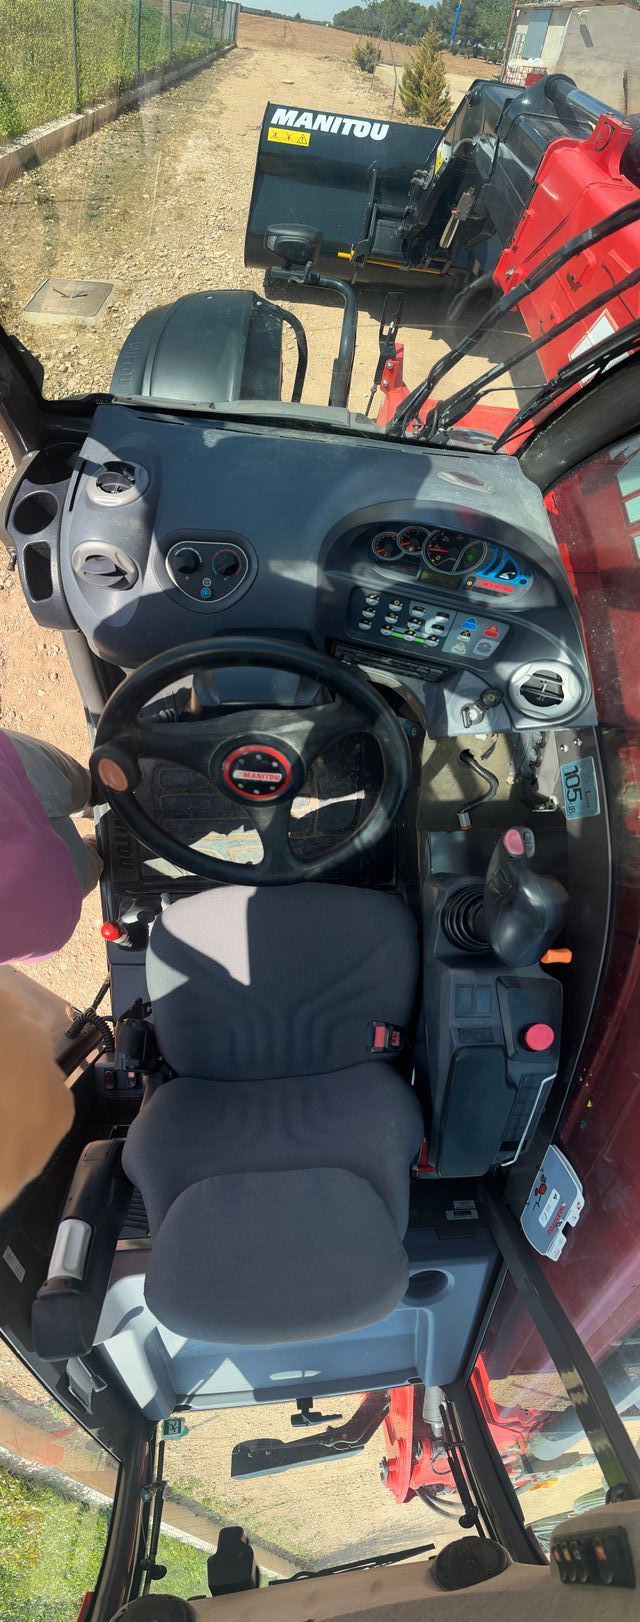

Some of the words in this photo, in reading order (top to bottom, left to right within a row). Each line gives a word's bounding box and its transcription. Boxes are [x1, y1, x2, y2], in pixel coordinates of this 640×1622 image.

[270, 108, 390, 141] MANITOU
[242, 771, 280, 781] MANITOU
[564, 764, 583, 802] 105
